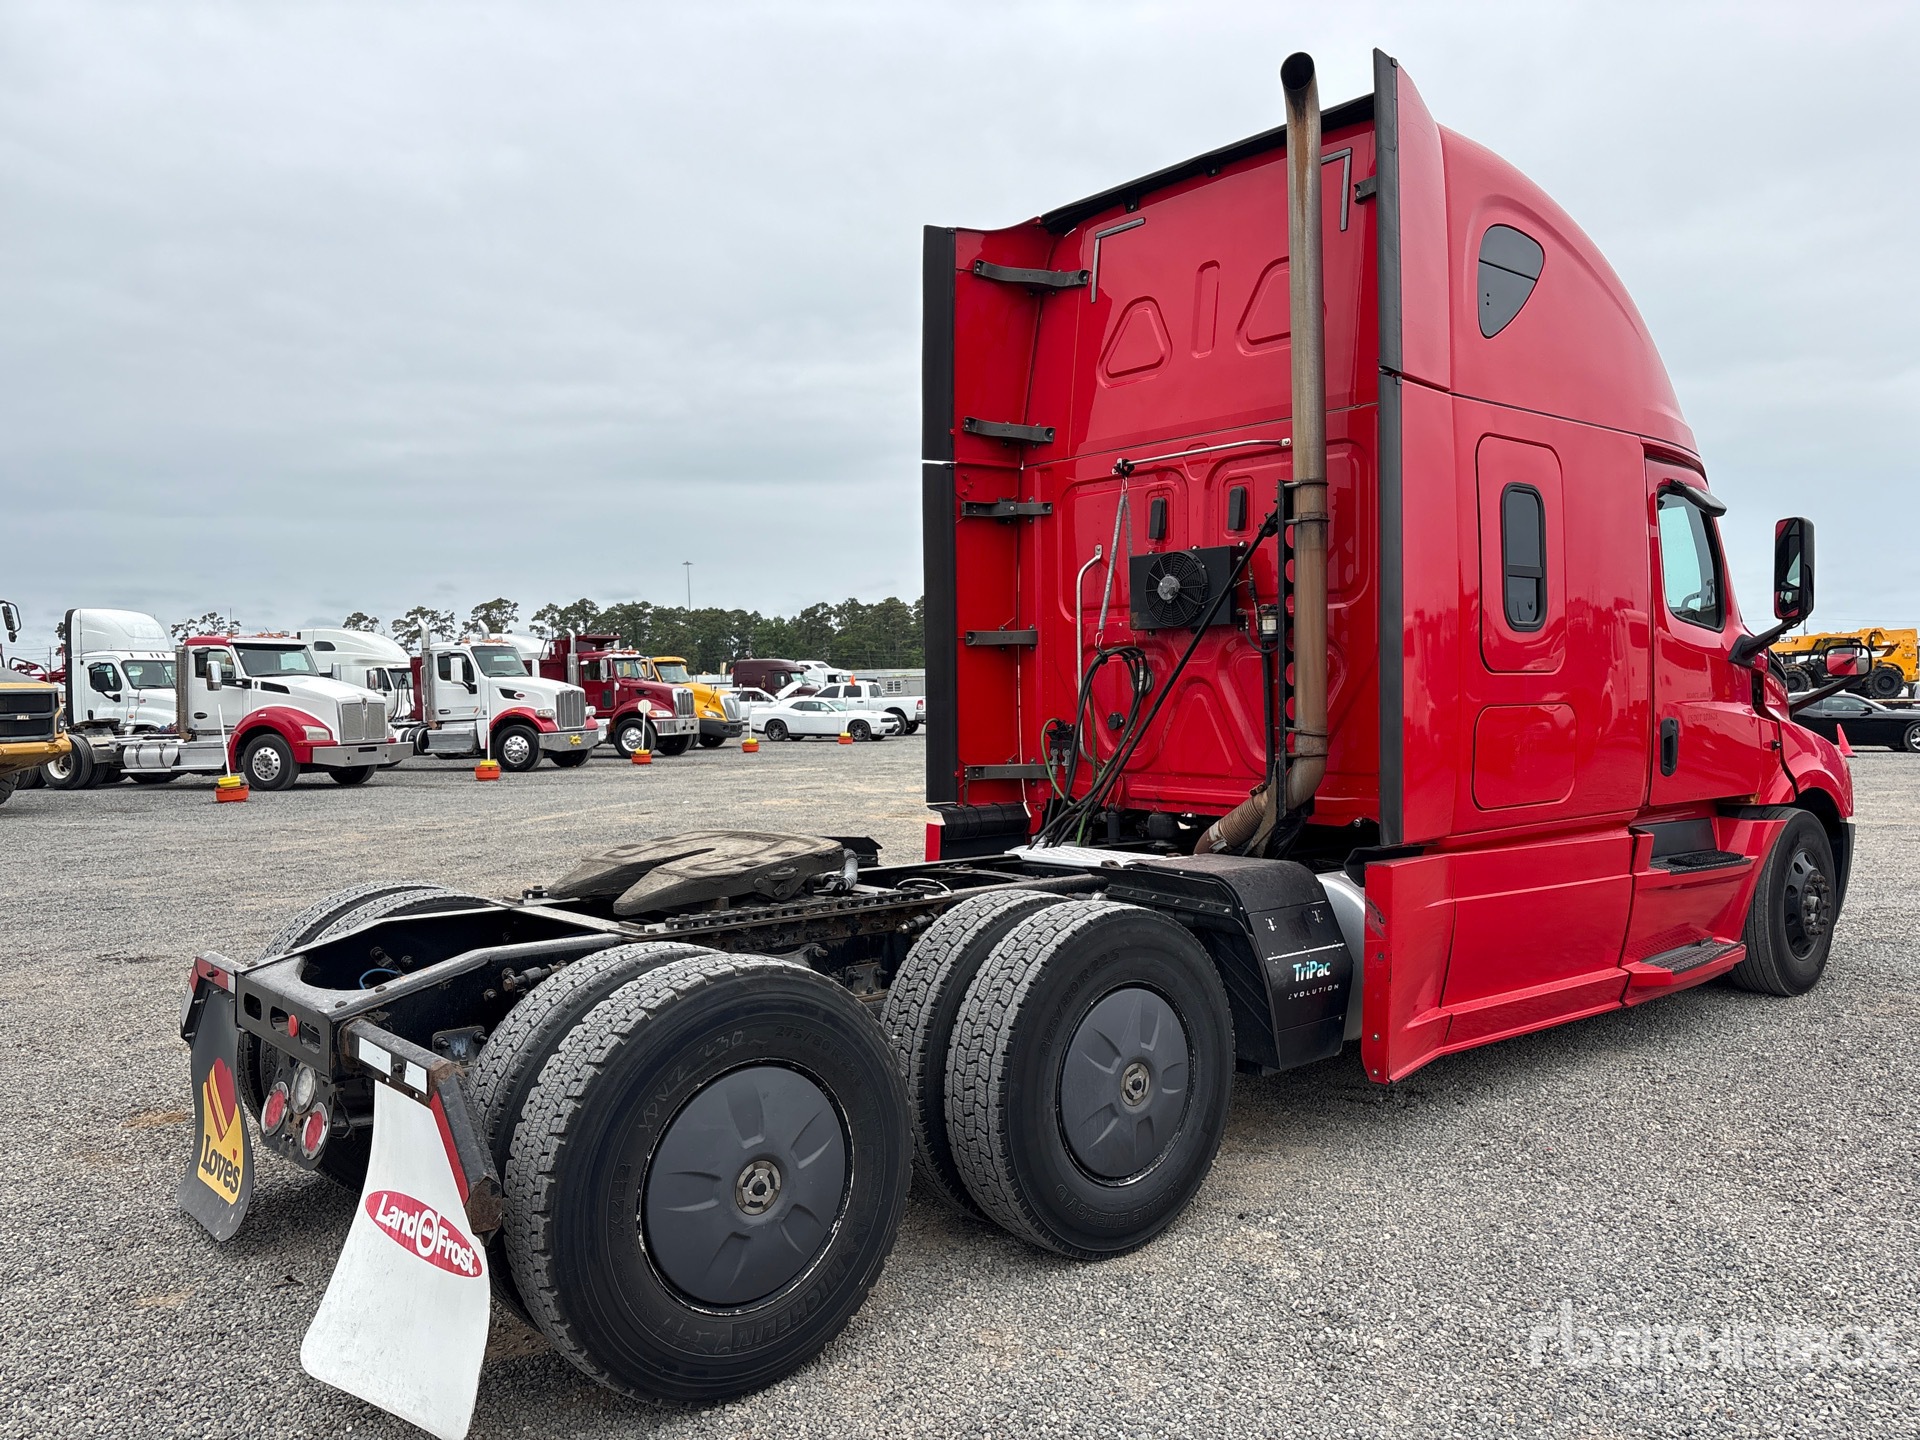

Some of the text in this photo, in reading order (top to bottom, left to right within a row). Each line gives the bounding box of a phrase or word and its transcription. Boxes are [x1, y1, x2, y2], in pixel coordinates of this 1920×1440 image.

[1292, 960, 1331, 982] TriPac
[375, 1194, 419, 1240] Land
[436, 1226, 475, 1275] Frost
[733, 1257, 847, 1349] MICHELIN
